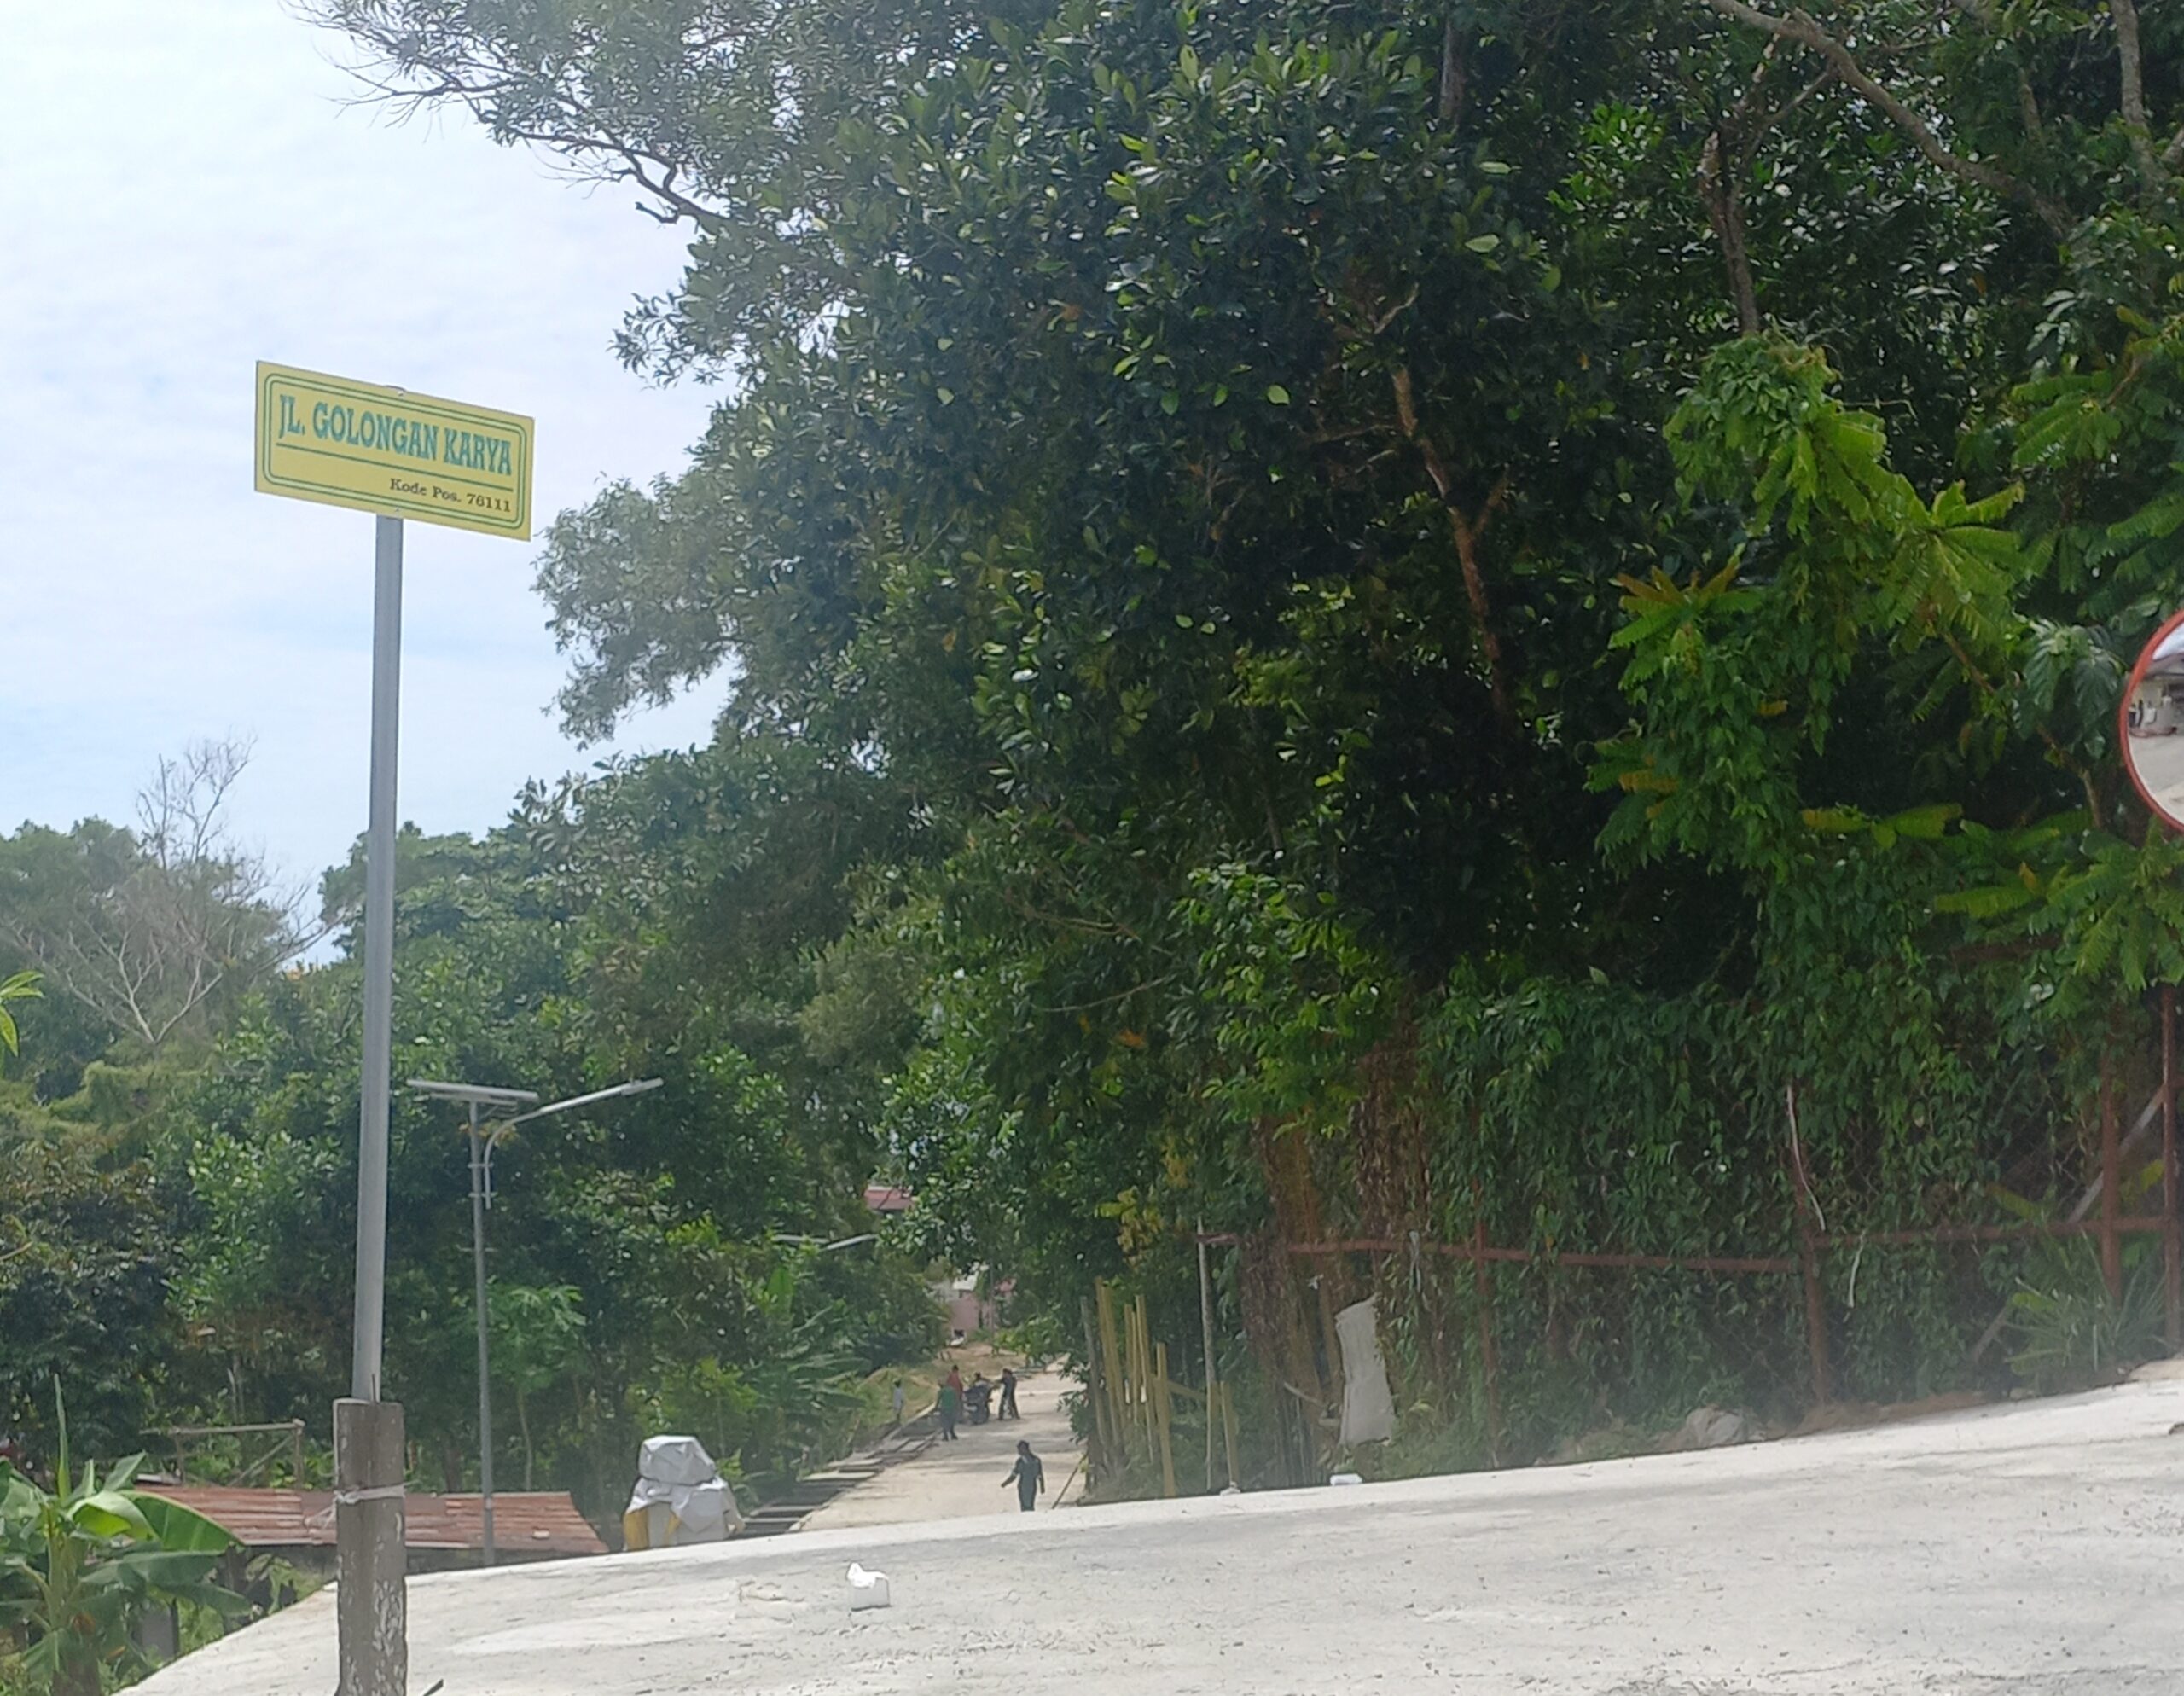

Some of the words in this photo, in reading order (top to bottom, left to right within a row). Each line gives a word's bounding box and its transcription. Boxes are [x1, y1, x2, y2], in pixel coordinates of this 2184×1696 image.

[278, 393, 305, 439] JL.
[312, 401, 439, 462] GOLONGAN
[444, 427, 513, 476] KARYA
[390, 478, 427, 497] Kode
[433, 485, 462, 502] Pos.
[467, 493, 512, 512] 76111
